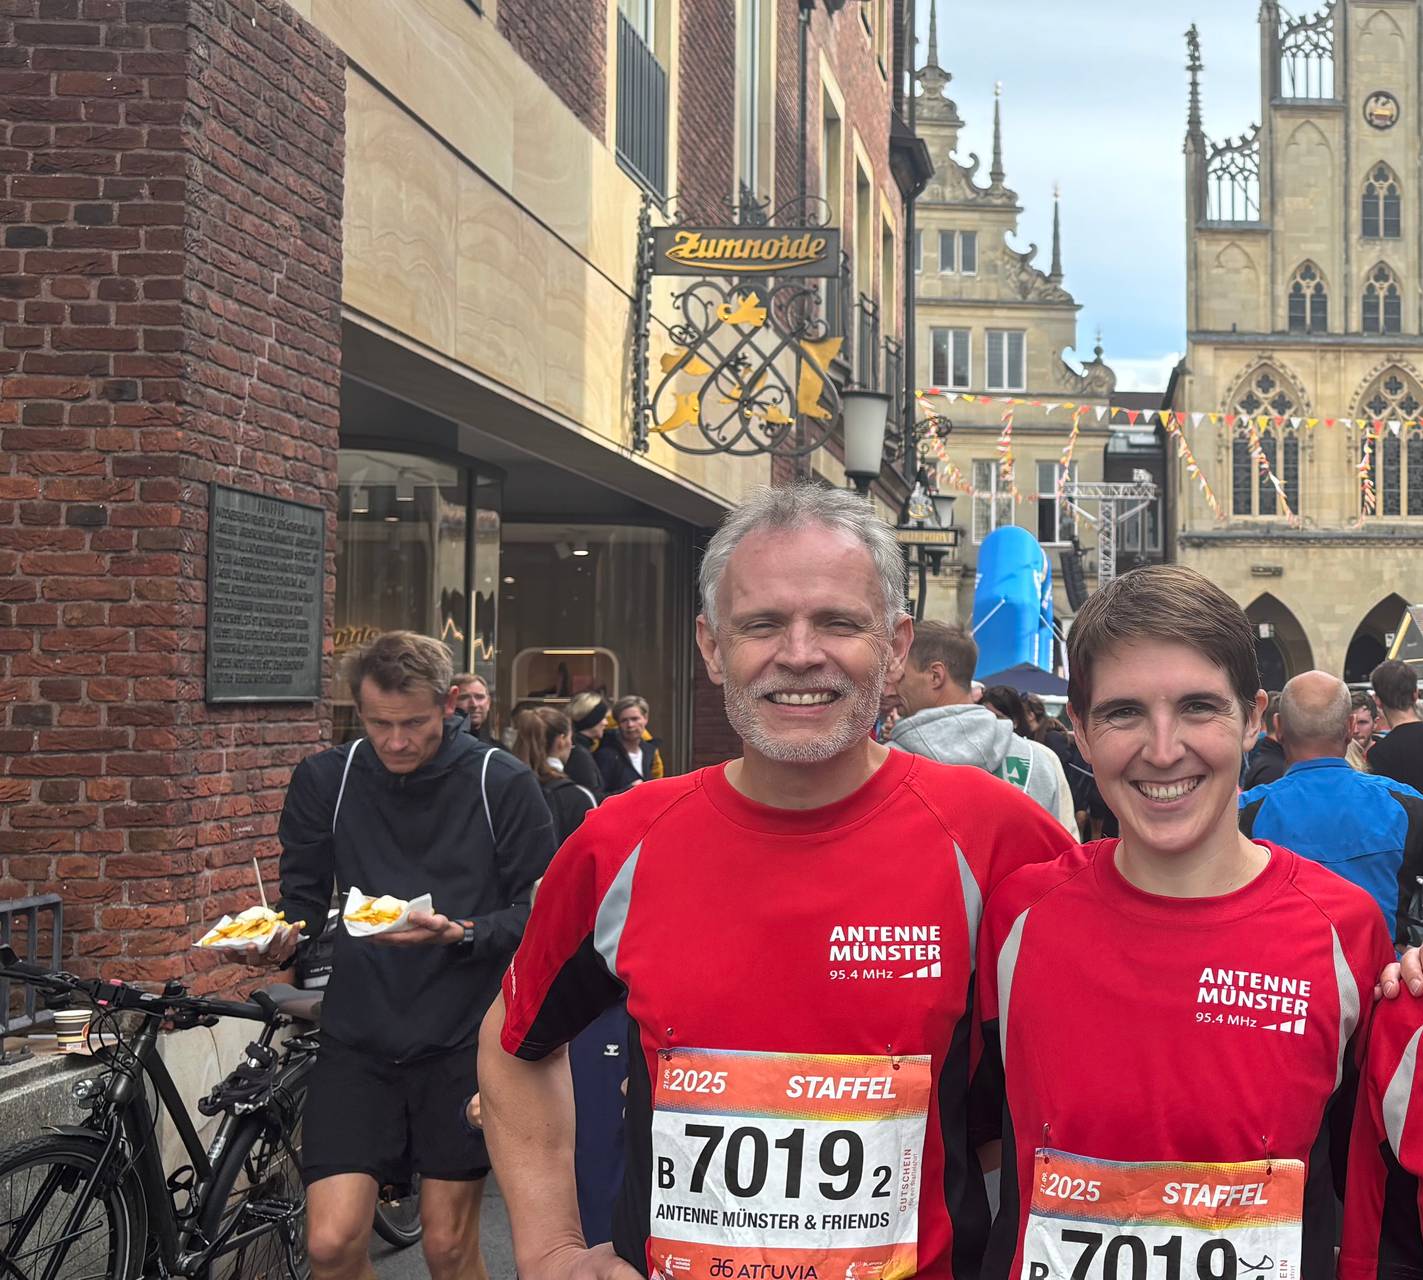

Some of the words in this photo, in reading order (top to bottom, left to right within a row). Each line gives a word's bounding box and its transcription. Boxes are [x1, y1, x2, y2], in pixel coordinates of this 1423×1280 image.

[829, 925, 941, 942] ANTENNE
[829, 942, 941, 961] MÜNSTER
[829, 969, 859, 980] 95.4
[862, 969, 894, 979] MHz
[1199, 967, 1312, 997] ANTENNE
[1197, 985, 1309, 1017] MÜNSTER
[1195, 1012, 1224, 1024] 95.4
[1227, 1014, 1257, 1028] MHz
[669, 1068, 729, 1094] 2025
[786, 1075, 897, 1099] STAFFEL
[657, 1156, 675, 1189] B
[684, 1123, 865, 1201] 7019
[871, 1165, 892, 1199] 2
[1045, 1173, 1102, 1201] 2025
[1162, 1182, 1270, 1208] STAFFEL
[655, 1203, 718, 1226] ANTENNE
[721, 1206, 799, 1230] MÜNSTER
[804, 1216, 817, 1230] &
[822, 1211, 890, 1230] FRIENDS
[1061, 1229, 1238, 1280] 7019
[737, 1264, 818, 1280] ATRUVIA
